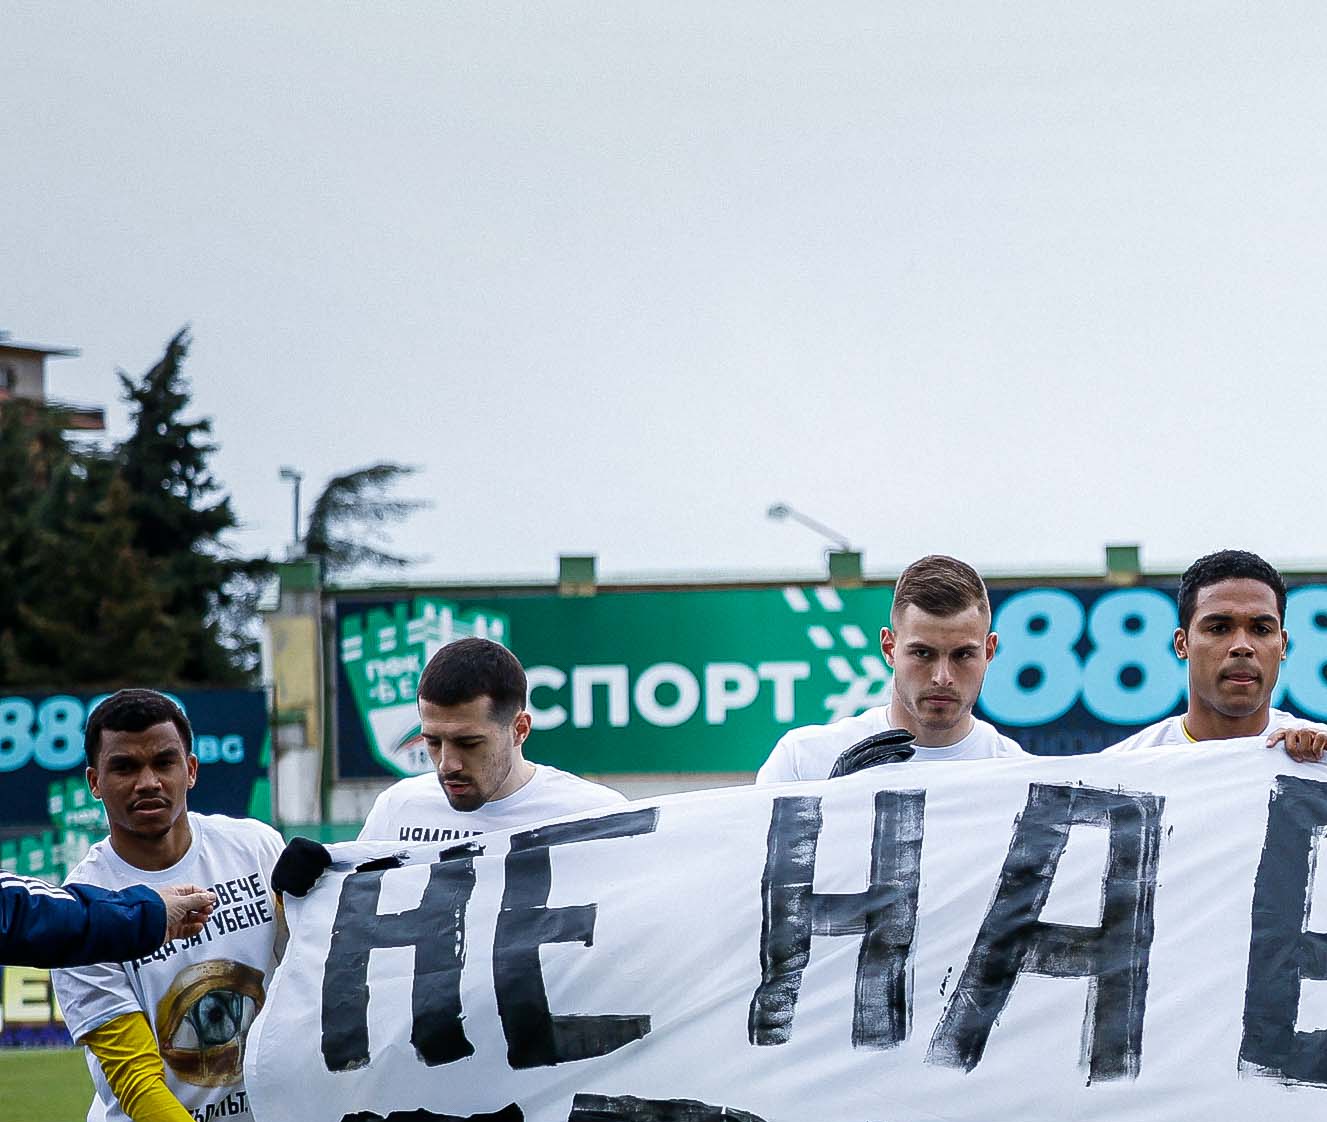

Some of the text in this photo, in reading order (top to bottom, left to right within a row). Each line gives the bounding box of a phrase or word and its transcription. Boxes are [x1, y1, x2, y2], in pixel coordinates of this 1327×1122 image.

[527, 661, 810, 732] СПОРТ
[321, 806, 661, 1071] НЕ
[748, 780, 1166, 1086] НА
